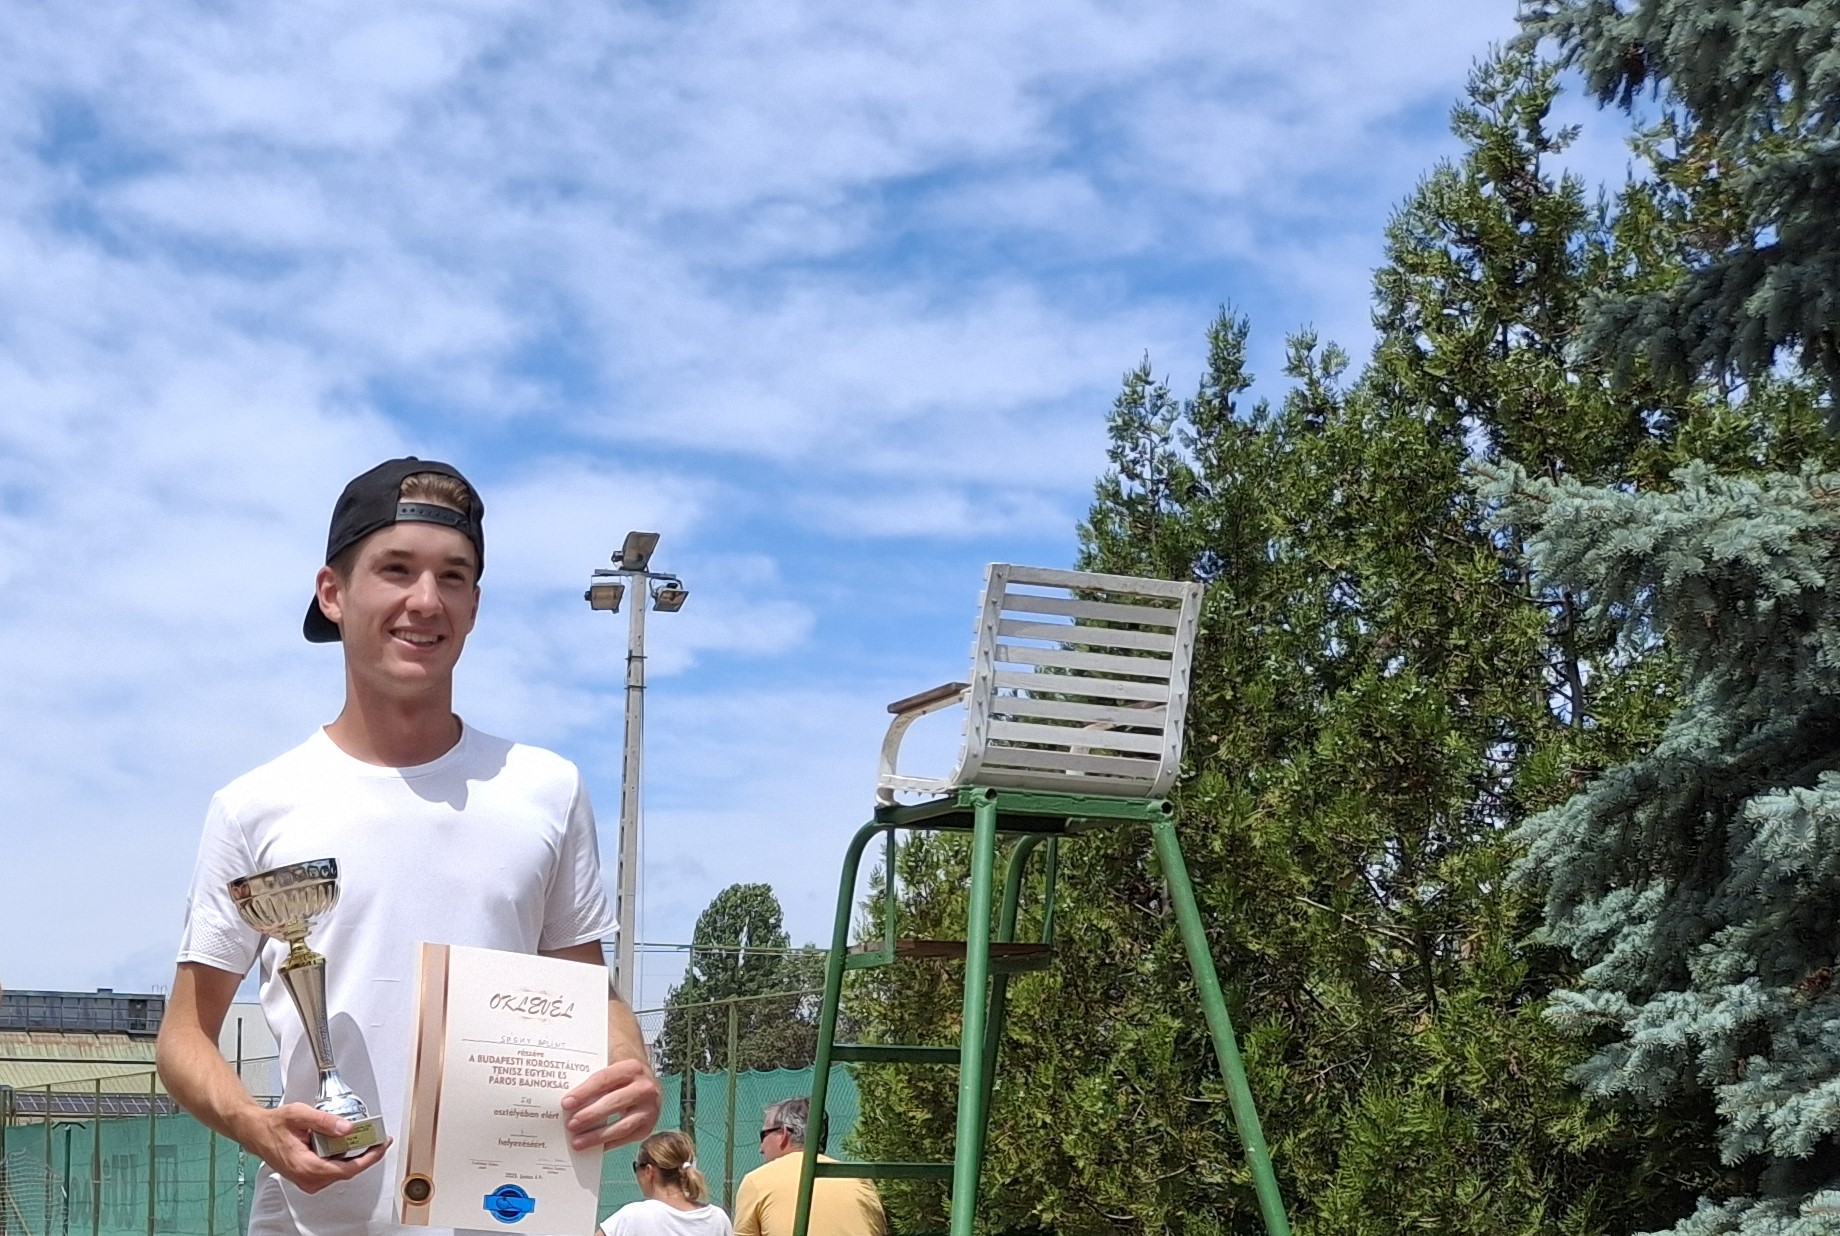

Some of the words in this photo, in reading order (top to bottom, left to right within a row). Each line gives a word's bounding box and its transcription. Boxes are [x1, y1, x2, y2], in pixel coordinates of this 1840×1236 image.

[489, 993, 575, 1019] OKLEVÉL
[468, 1054, 475, 1063] A
[477, 1054, 523, 1067] BUDAPESTI
[526, 1058, 590, 1072] KOROSZTÁLYOS
[492, 1066, 523, 1076] TENISZ
